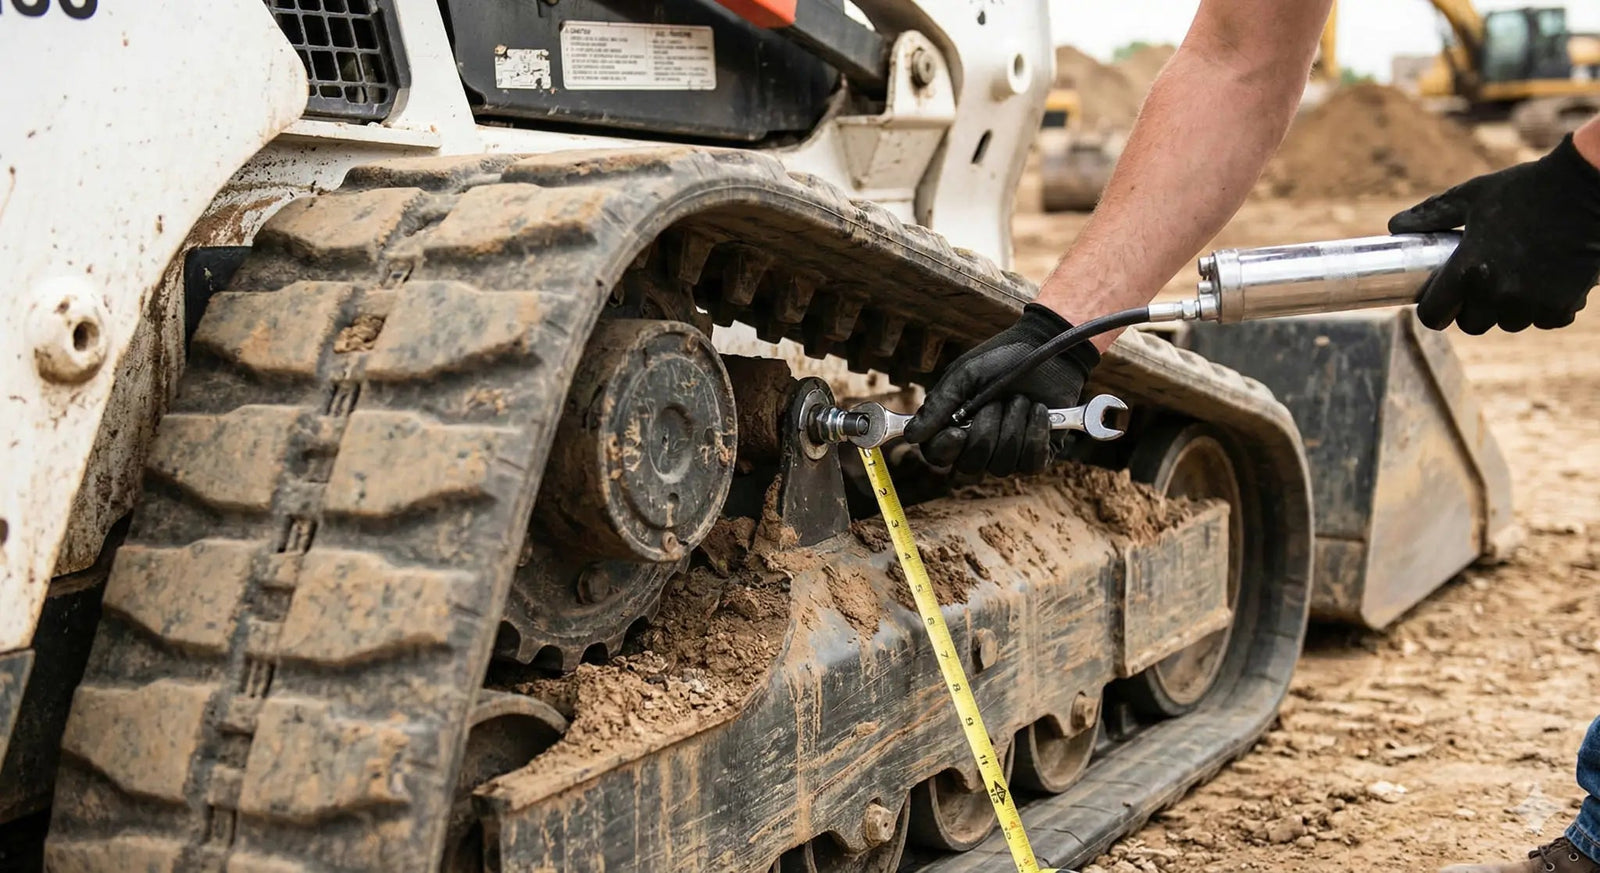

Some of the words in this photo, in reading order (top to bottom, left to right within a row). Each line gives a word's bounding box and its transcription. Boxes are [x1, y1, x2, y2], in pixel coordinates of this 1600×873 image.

[878, 487, 888, 497] 2
[891, 519, 899, 528] 3
[903, 552, 912, 560] 4
[915, 584, 923, 593] 5
[927, 617, 935, 626] 6
[940, 650, 949, 658] 7
[952, 683, 961, 692] 8
[965, 717, 974, 726] 9
[979, 754, 989, 766] 11
